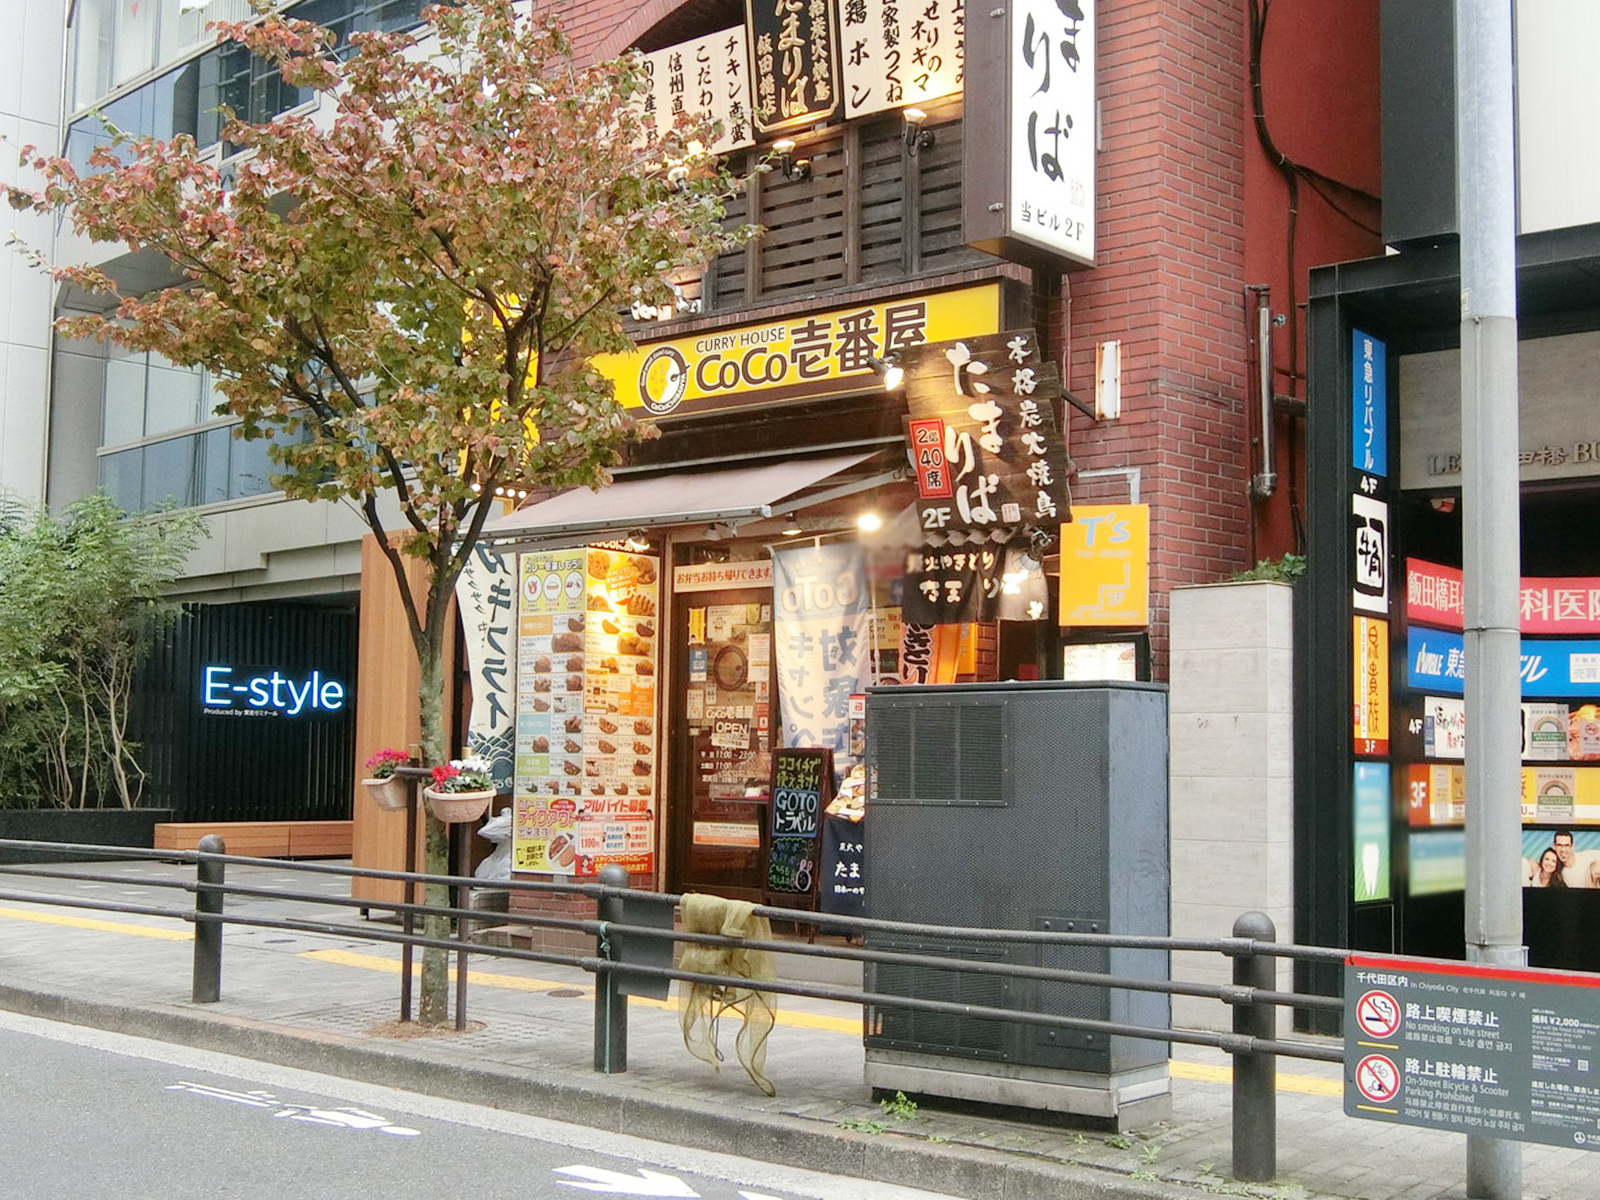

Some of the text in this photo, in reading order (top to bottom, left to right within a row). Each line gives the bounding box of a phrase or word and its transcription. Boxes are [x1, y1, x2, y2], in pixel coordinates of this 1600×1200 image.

[923, 1, 943, 72] せりの
[911, 20, 930, 92] ネギマ
[757, 33, 777, 116] 飯田橋店
[1021, 200, 1084, 241] 当ビル2F
[696, 326, 785, 354] CURRY HOUSE
[1363, 338, 1375, 470] 東急リバブル
[944, 341, 1002, 525] たまりば
[1007, 336, 1057, 519] 本格炭火焼鳥
[1360, 475, 1378, 494] 4F
[922, 507, 951, 529] 2F
[1078, 512, 1130, 546] T's
[907, 551, 995, 574] 火やきとり
[1358, 530, 1383, 580] 牛角
[1408, 569, 1464, 613] 飯田橋耳
[204, 666, 344, 715] E-style
[716, 721, 748, 734] OPEN
[1409, 718, 1424, 735] 4F
[1365, 739, 1376, 754] 3F
[1410, 781, 1427, 809] 3F
[775, 811, 817, 833] トラベル
[1356, 971, 1409, 988] 千代田区内
[1419, 982, 1445, 993] Chiyoda
[1446, 984, 1460, 994] City
[1405, 1003, 1500, 1028] 路上喫煙禁止
[1549, 1016, 1580, 1027] ¥2,000
[1405, 1021, 1500, 1039] No smoking on the street
[1405, 1058, 1498, 1084] 路上駐輪禁止
[1405, 1075, 1441, 1088] On-Street
[1443, 1080, 1470, 1093] Bicycle
[1480, 1085, 1510, 1098] Scooter
[1405, 1086, 1475, 1103] Parking Prohibited
